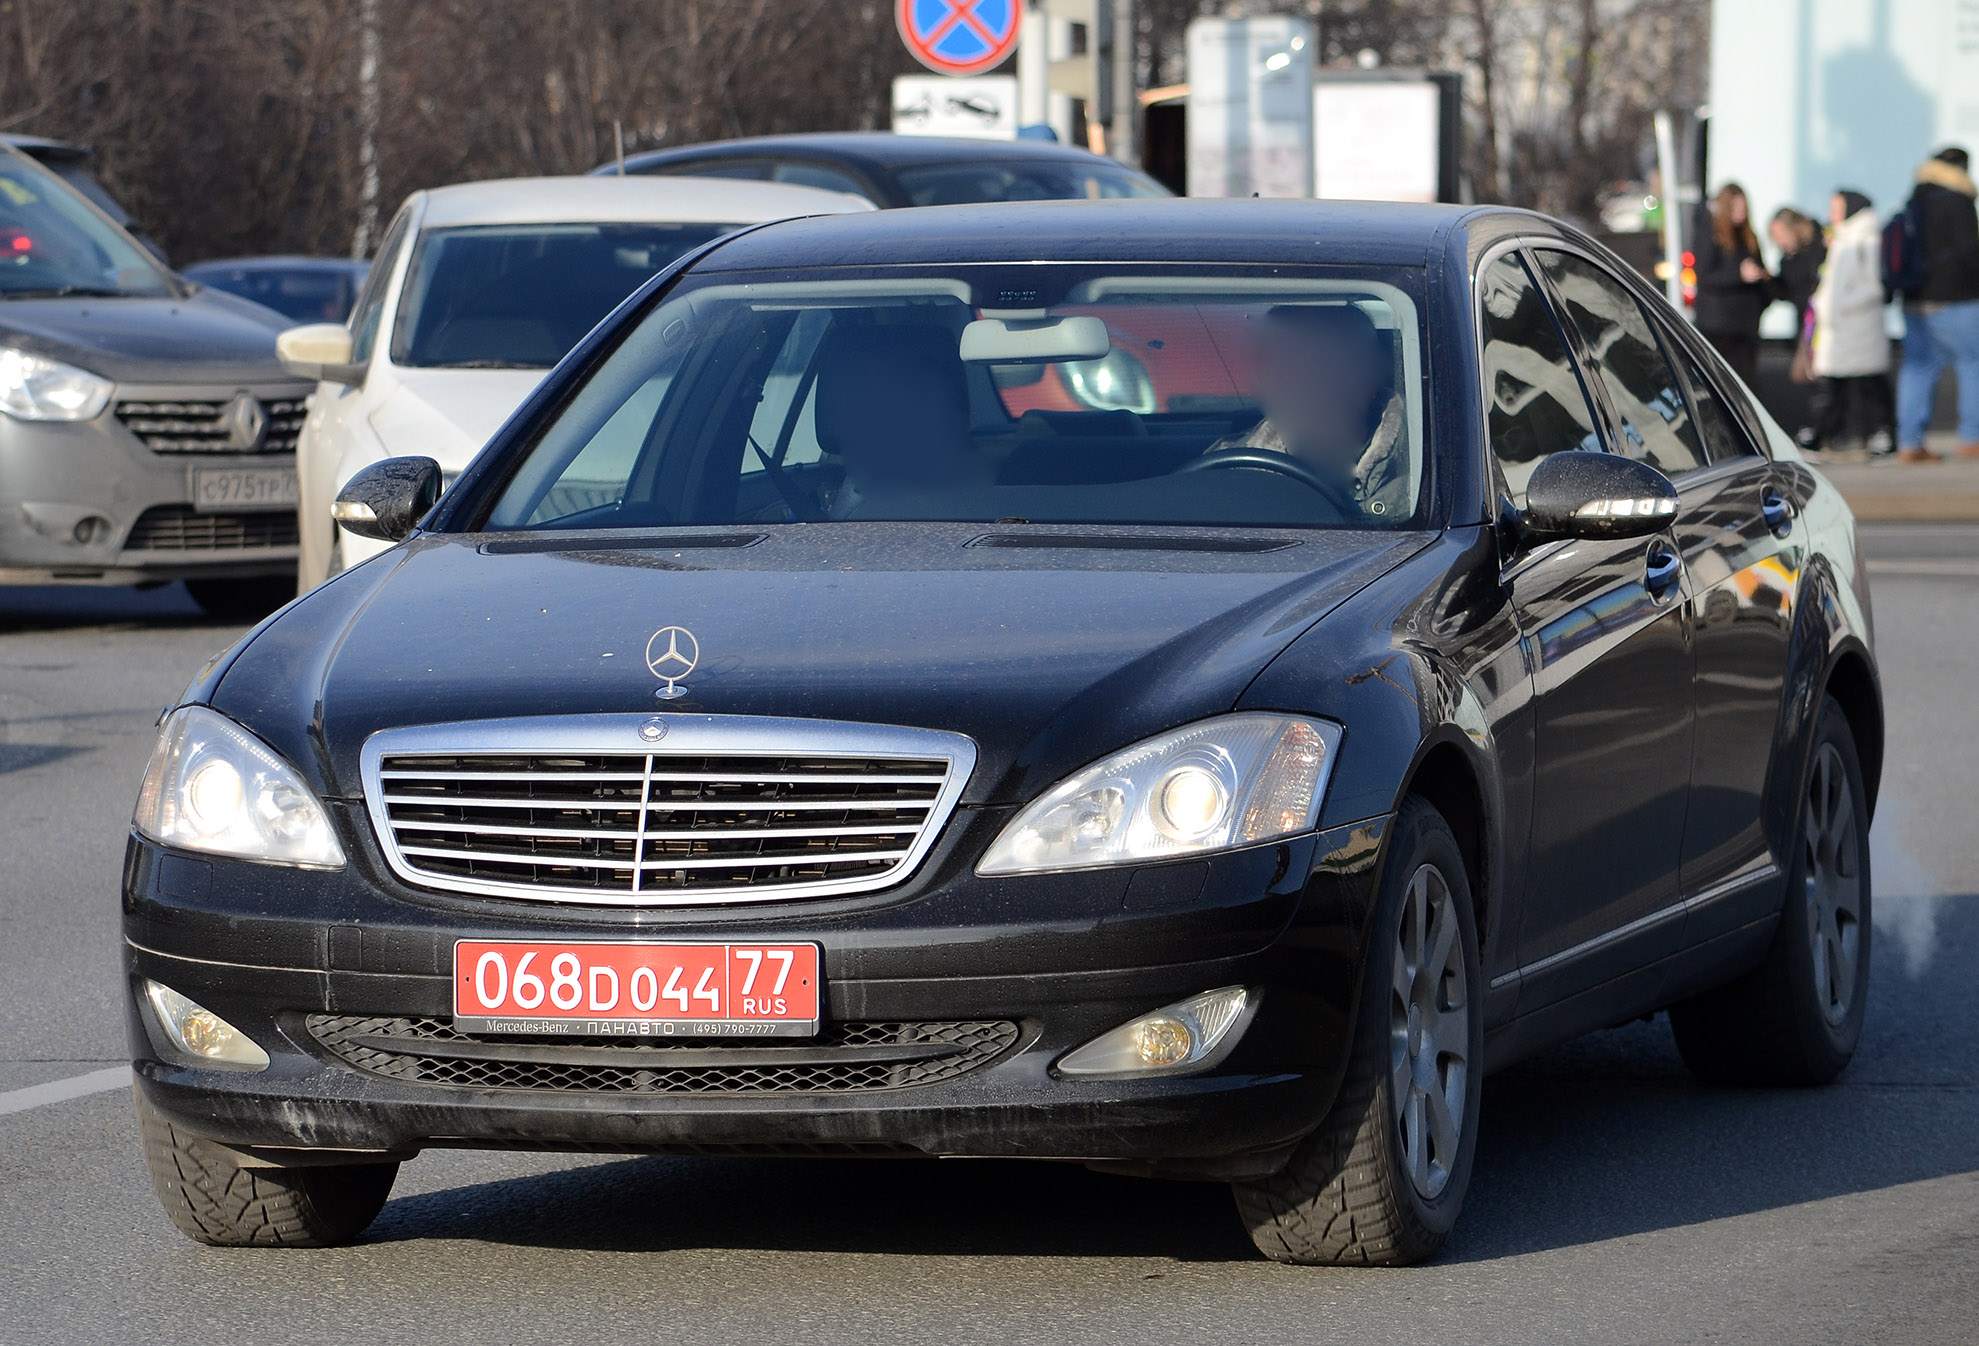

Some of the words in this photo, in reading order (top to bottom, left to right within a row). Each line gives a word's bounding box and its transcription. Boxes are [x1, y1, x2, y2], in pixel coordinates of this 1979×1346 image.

[736, 950, 794, 996] 77
[743, 998, 787, 1015] RUS
[486, 1020, 569, 1033] Mercedes-Benz
[587, 1021, 675, 1035] ПАНАВТО
[693, 1024, 721, 1035] (495)
[725, 1024, 777, 1034] 790-7777
